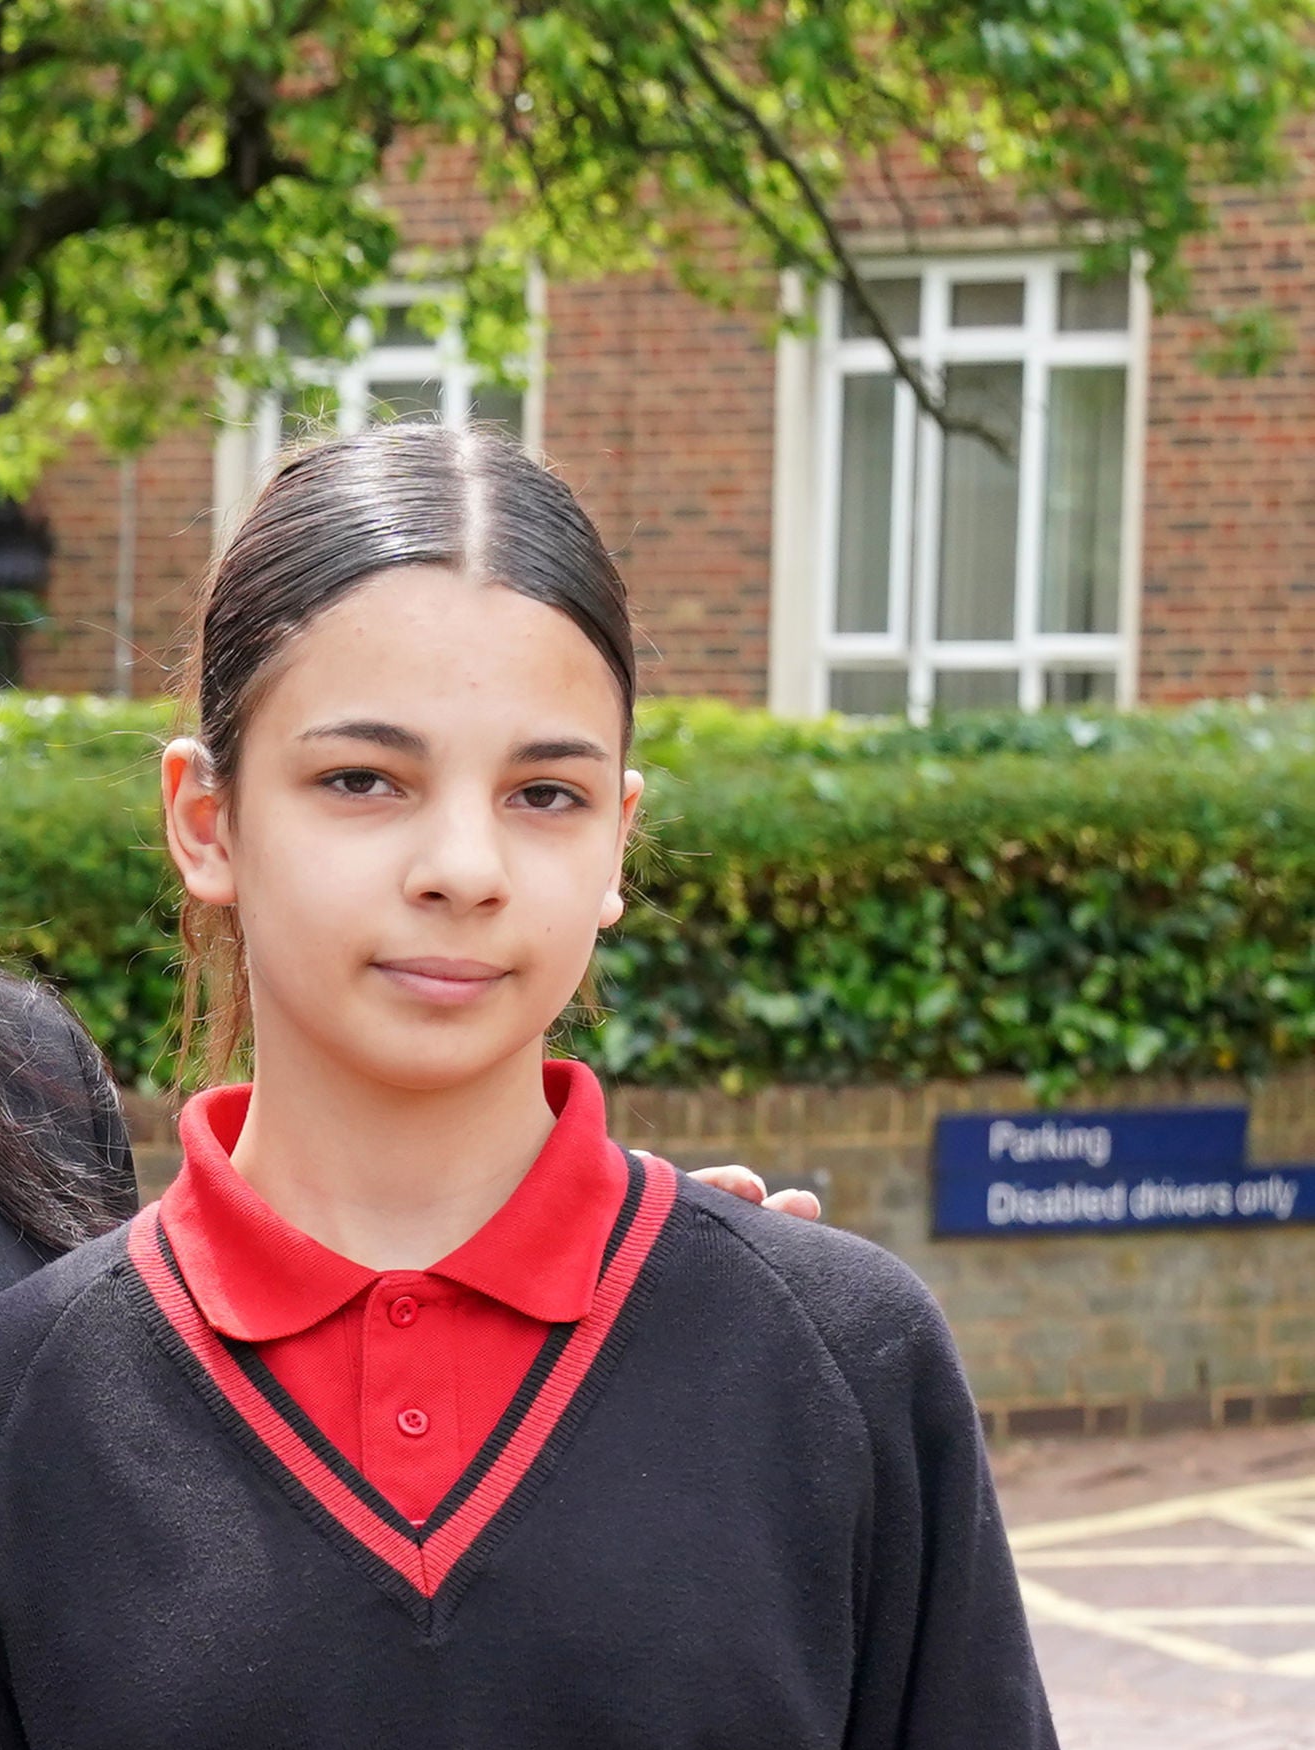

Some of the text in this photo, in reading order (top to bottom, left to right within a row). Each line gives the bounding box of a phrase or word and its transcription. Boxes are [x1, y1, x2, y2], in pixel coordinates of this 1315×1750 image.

[989, 1119, 1112, 1168] Parking
[987, 1173, 1299, 1226] Disabled drivers only
